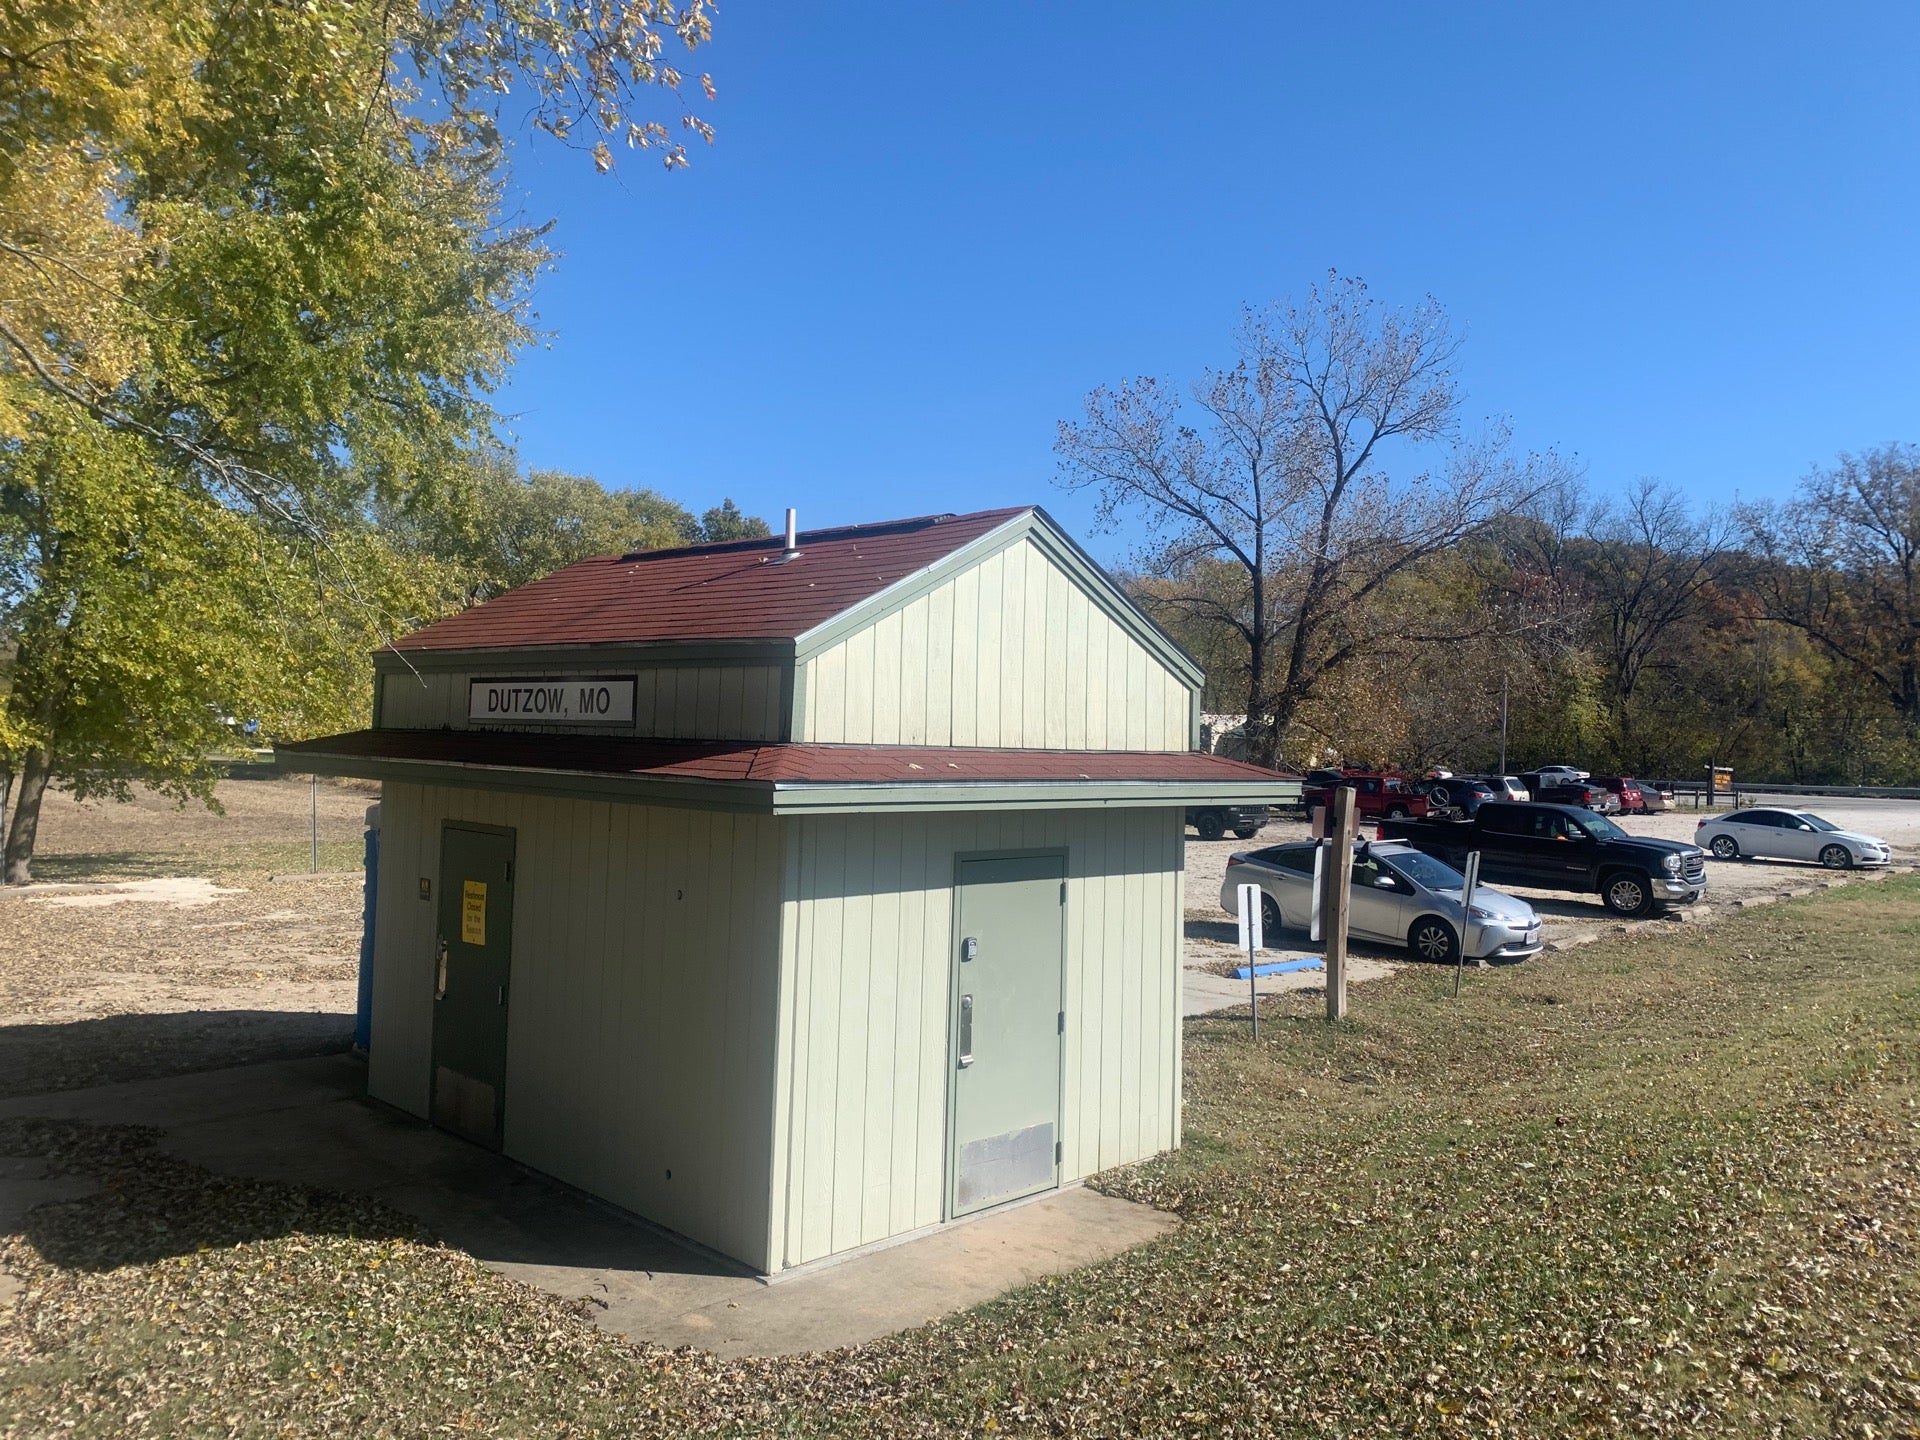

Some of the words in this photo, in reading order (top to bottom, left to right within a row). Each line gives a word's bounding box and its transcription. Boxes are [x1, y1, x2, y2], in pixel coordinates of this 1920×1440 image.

[488, 687, 568, 718] DUTZOW,
[579, 687, 611, 714] MO
[467, 901, 481, 912] Closed
